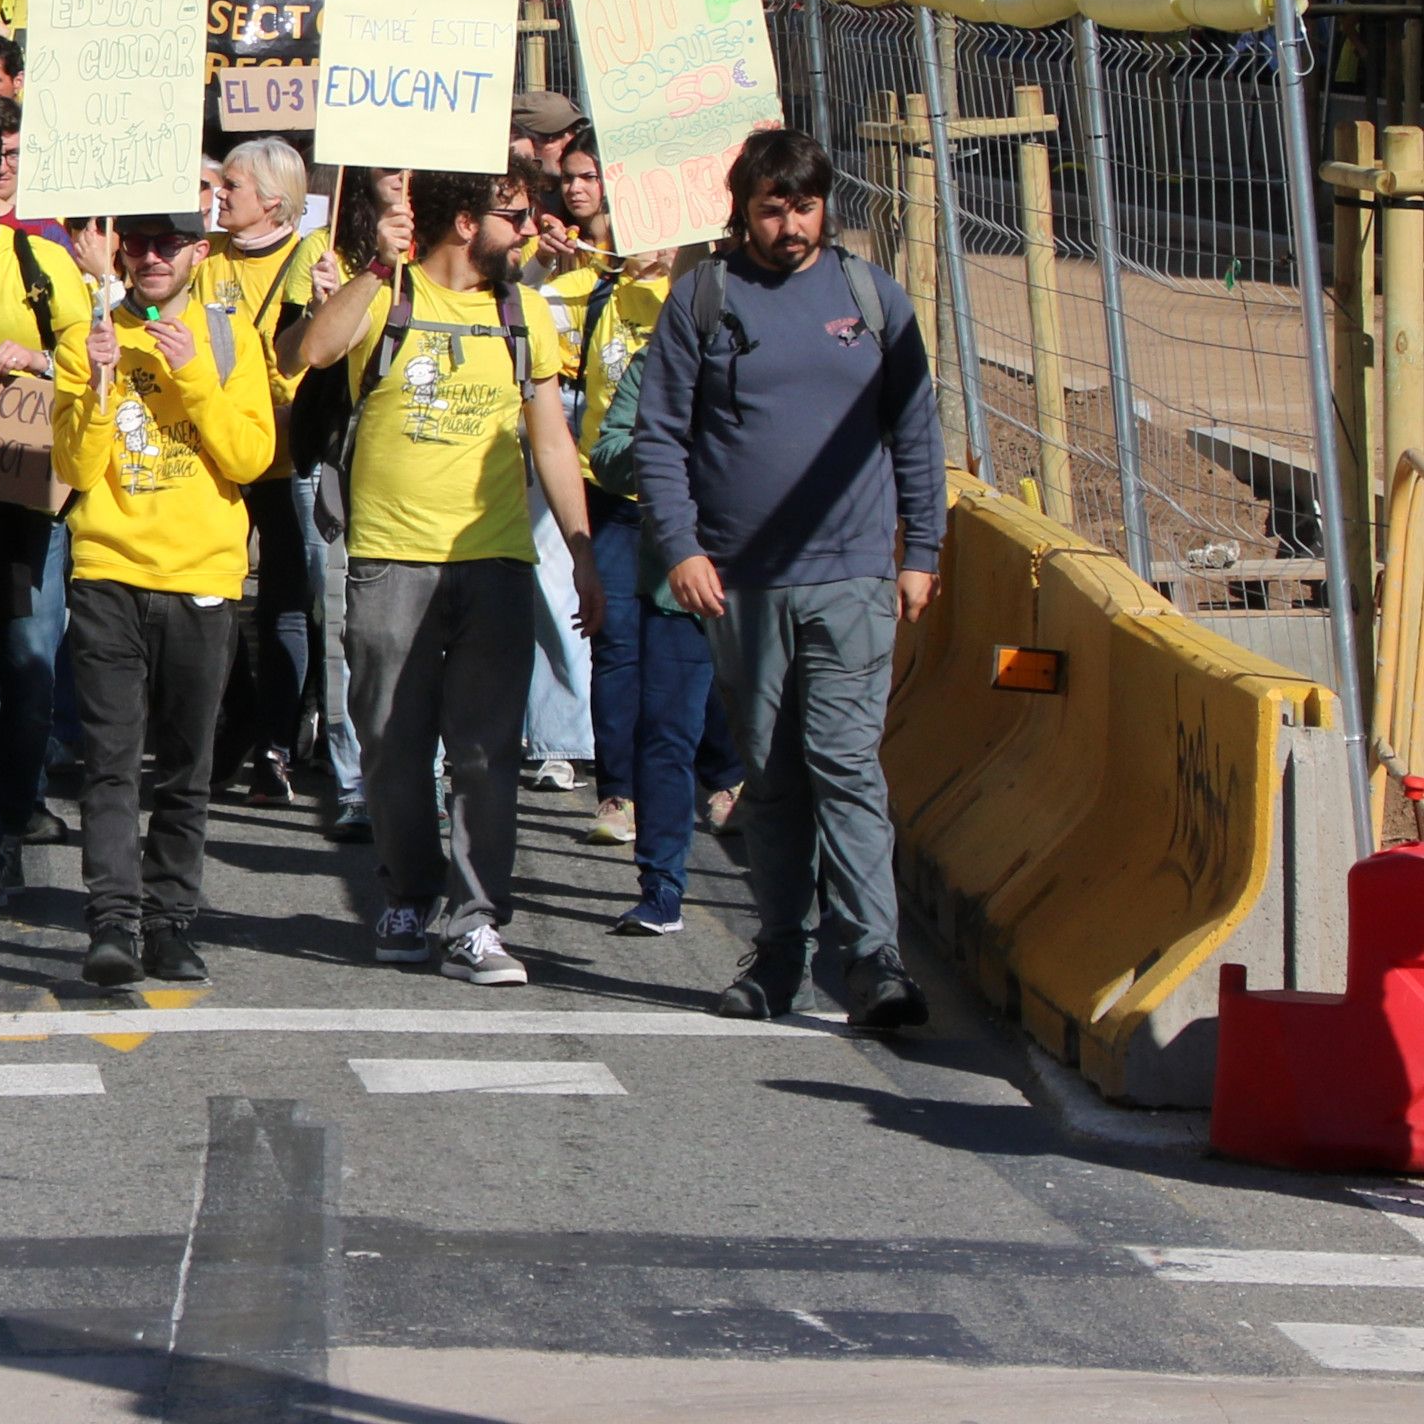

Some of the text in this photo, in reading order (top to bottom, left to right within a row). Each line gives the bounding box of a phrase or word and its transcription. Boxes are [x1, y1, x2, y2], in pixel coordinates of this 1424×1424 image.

[344, 9, 516, 49] TAMBÉ ESTEM
[77, 24, 196, 81] CUIDAR
[85, 91, 133, 126] QUI
[225, 78, 304, 114] EL 0-3
[324, 65, 494, 114] EDUCANT
